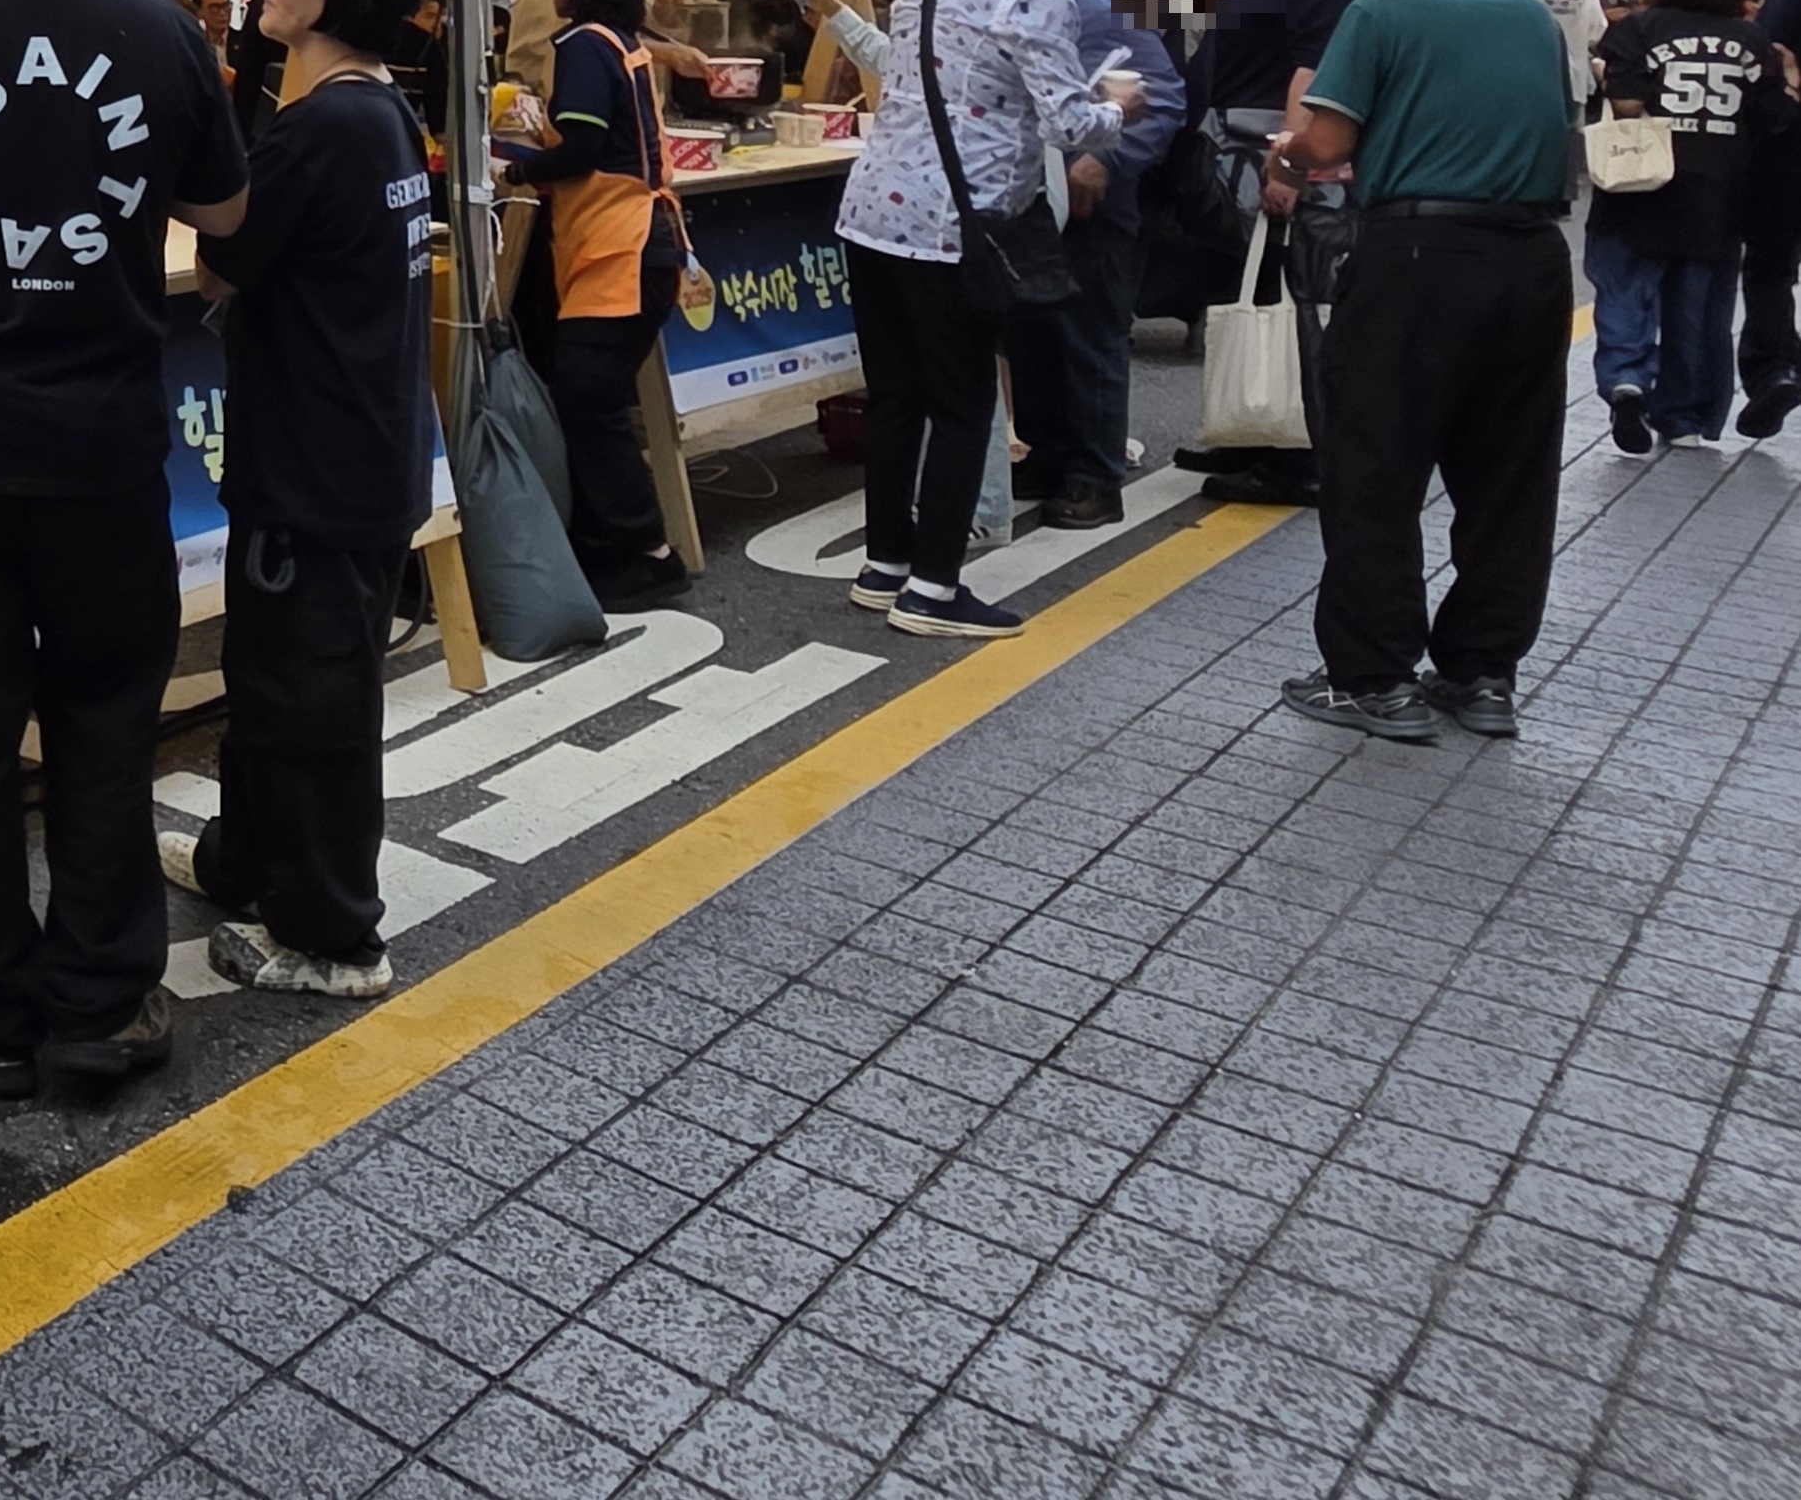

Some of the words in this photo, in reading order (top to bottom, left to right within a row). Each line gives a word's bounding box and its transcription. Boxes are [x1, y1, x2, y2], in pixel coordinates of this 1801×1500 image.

[1660, 60, 1743, 117] 55
[11, 277, 75, 291] LONDON
[722, 264, 797, 323] 약수시장
